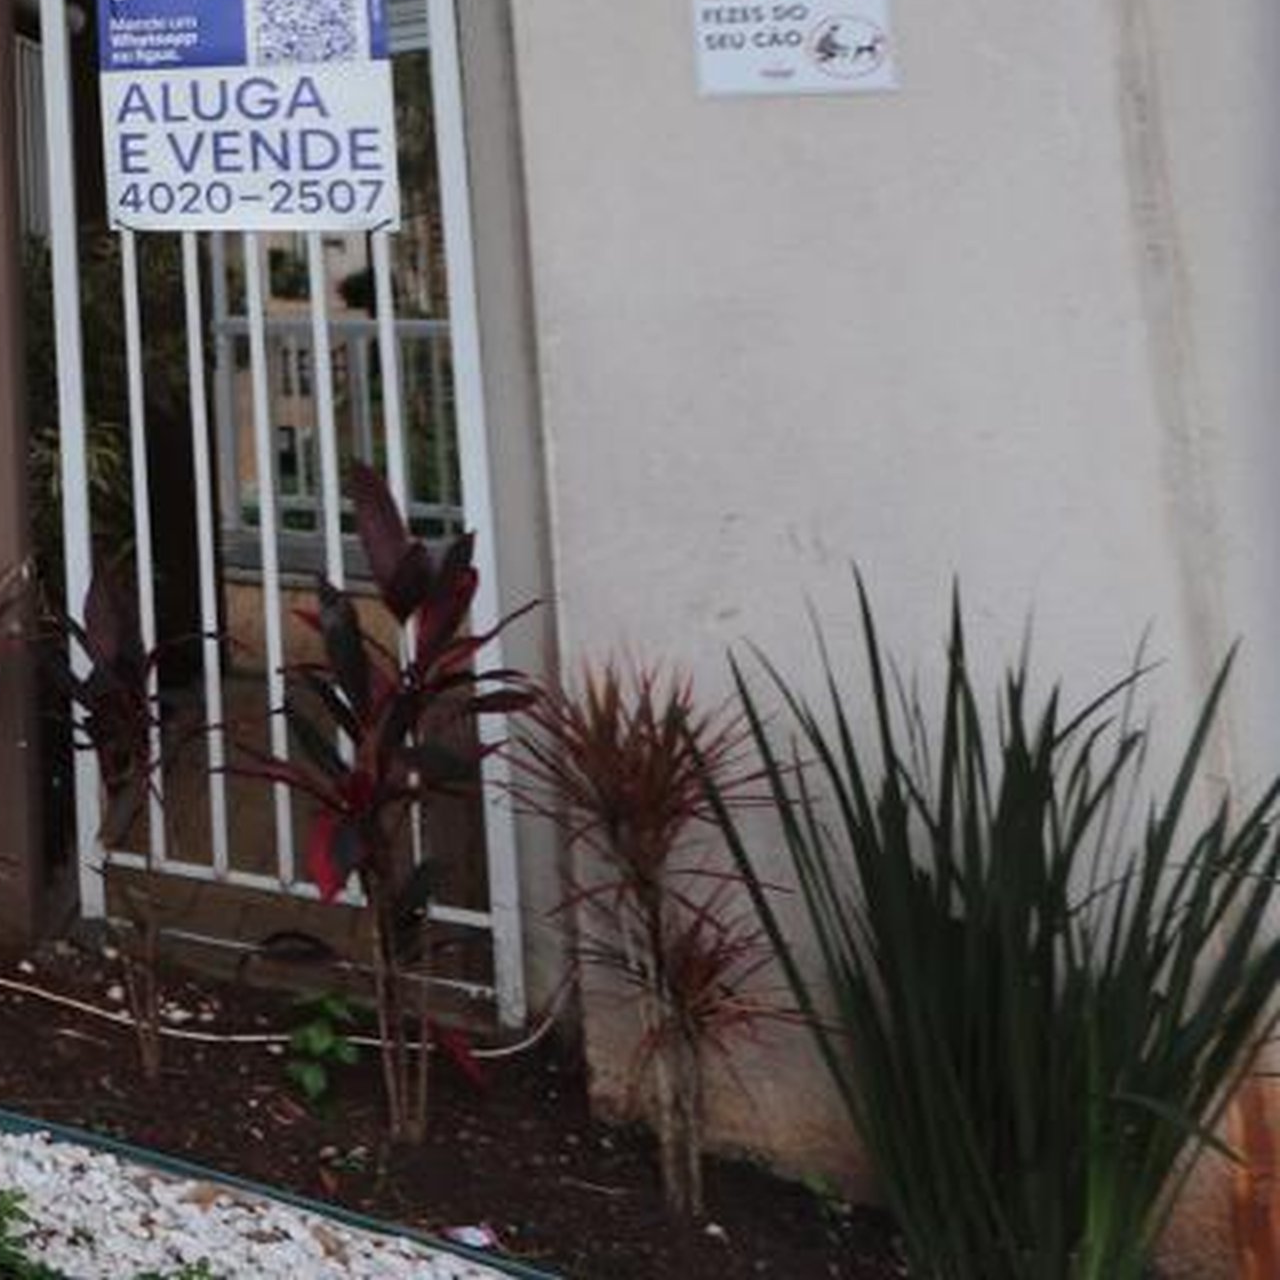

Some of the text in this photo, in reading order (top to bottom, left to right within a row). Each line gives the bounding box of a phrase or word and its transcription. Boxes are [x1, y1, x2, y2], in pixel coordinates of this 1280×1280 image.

[117, 76, 330, 125] ALUGA
[119, 127, 383, 175] E VENDE
[118, 179, 385, 215] 4020-2507
